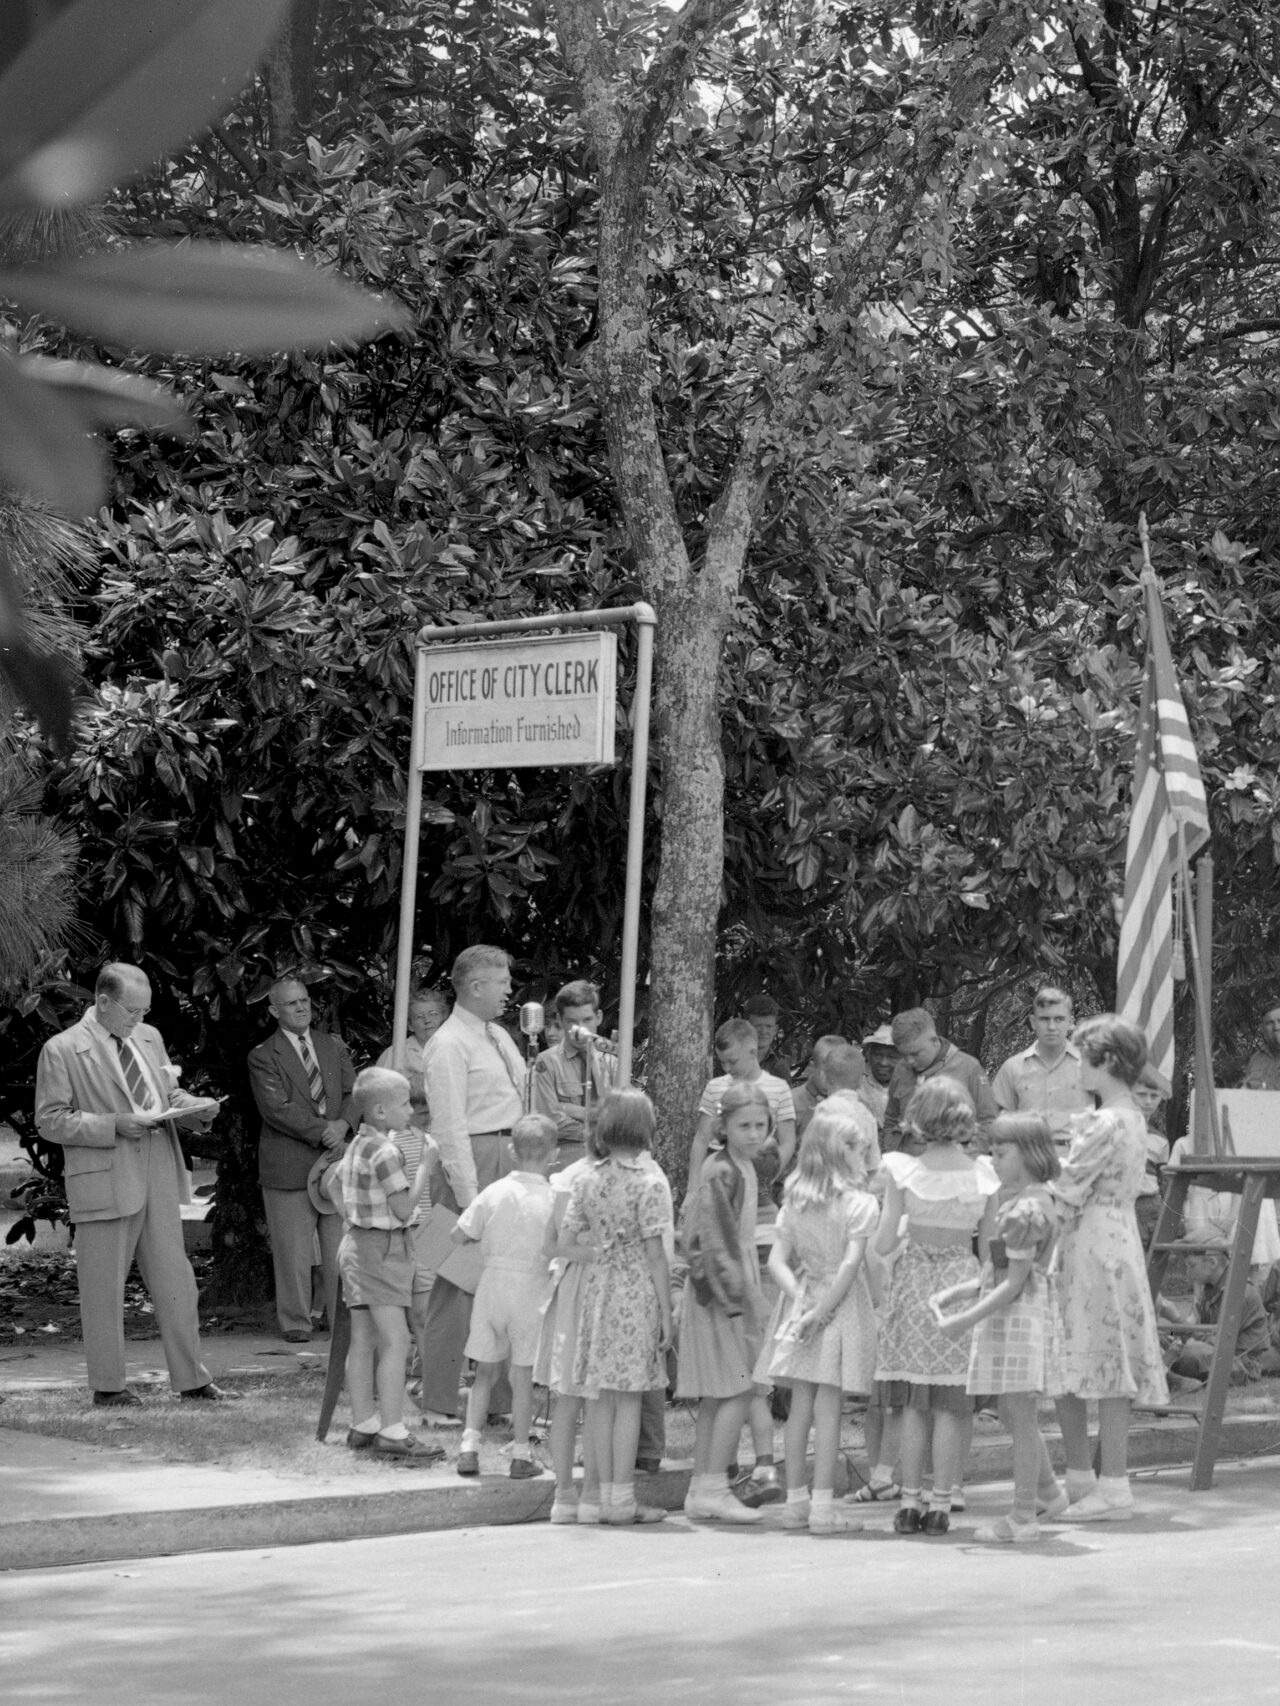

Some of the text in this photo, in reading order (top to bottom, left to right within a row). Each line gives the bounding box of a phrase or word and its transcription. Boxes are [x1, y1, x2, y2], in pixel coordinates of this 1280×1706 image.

[429, 658, 599, 703] OFFICE OF CITY CLERK
[446, 714, 581, 747] Information Furnished
